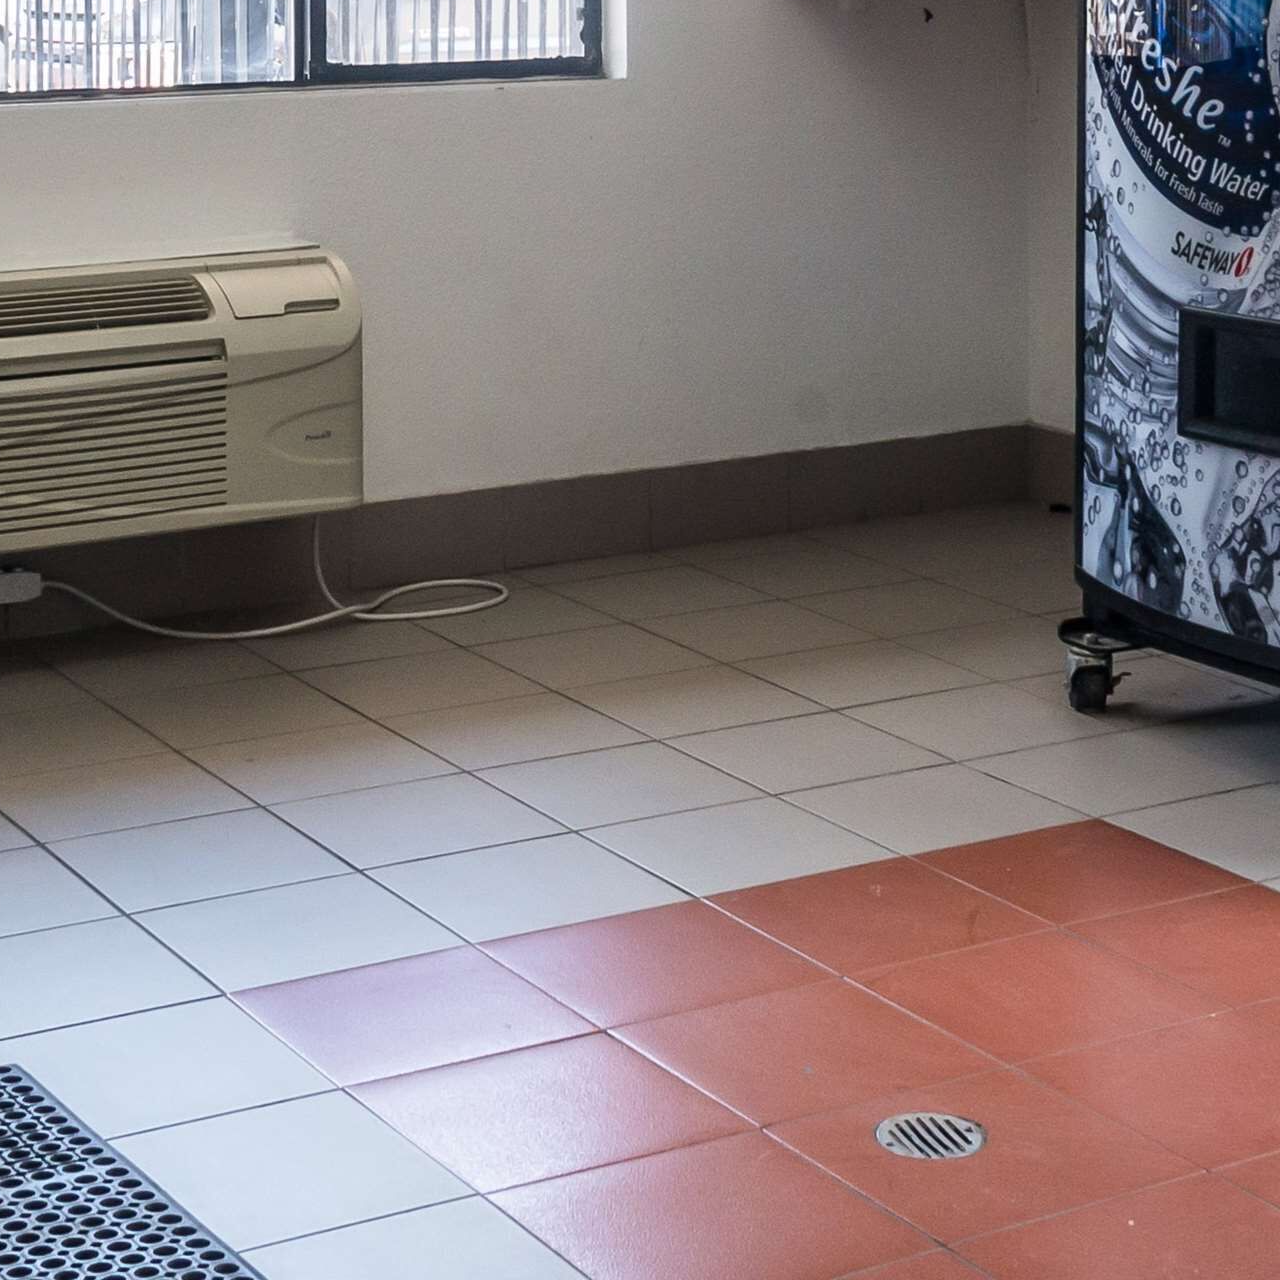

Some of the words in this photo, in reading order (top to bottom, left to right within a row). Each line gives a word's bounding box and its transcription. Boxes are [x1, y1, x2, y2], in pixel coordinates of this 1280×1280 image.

[1122, 108, 1153, 167] Minerals
[1153, 159, 1169, 183] for
[1169, 174, 1197, 204] Fresh
[1197, 193, 1224, 217] Taste
[1130, 80, 1207, 181] Drinking
[1208, 160, 1270, 202] Water
[1170, 231, 1239, 277] SAFEWAY
